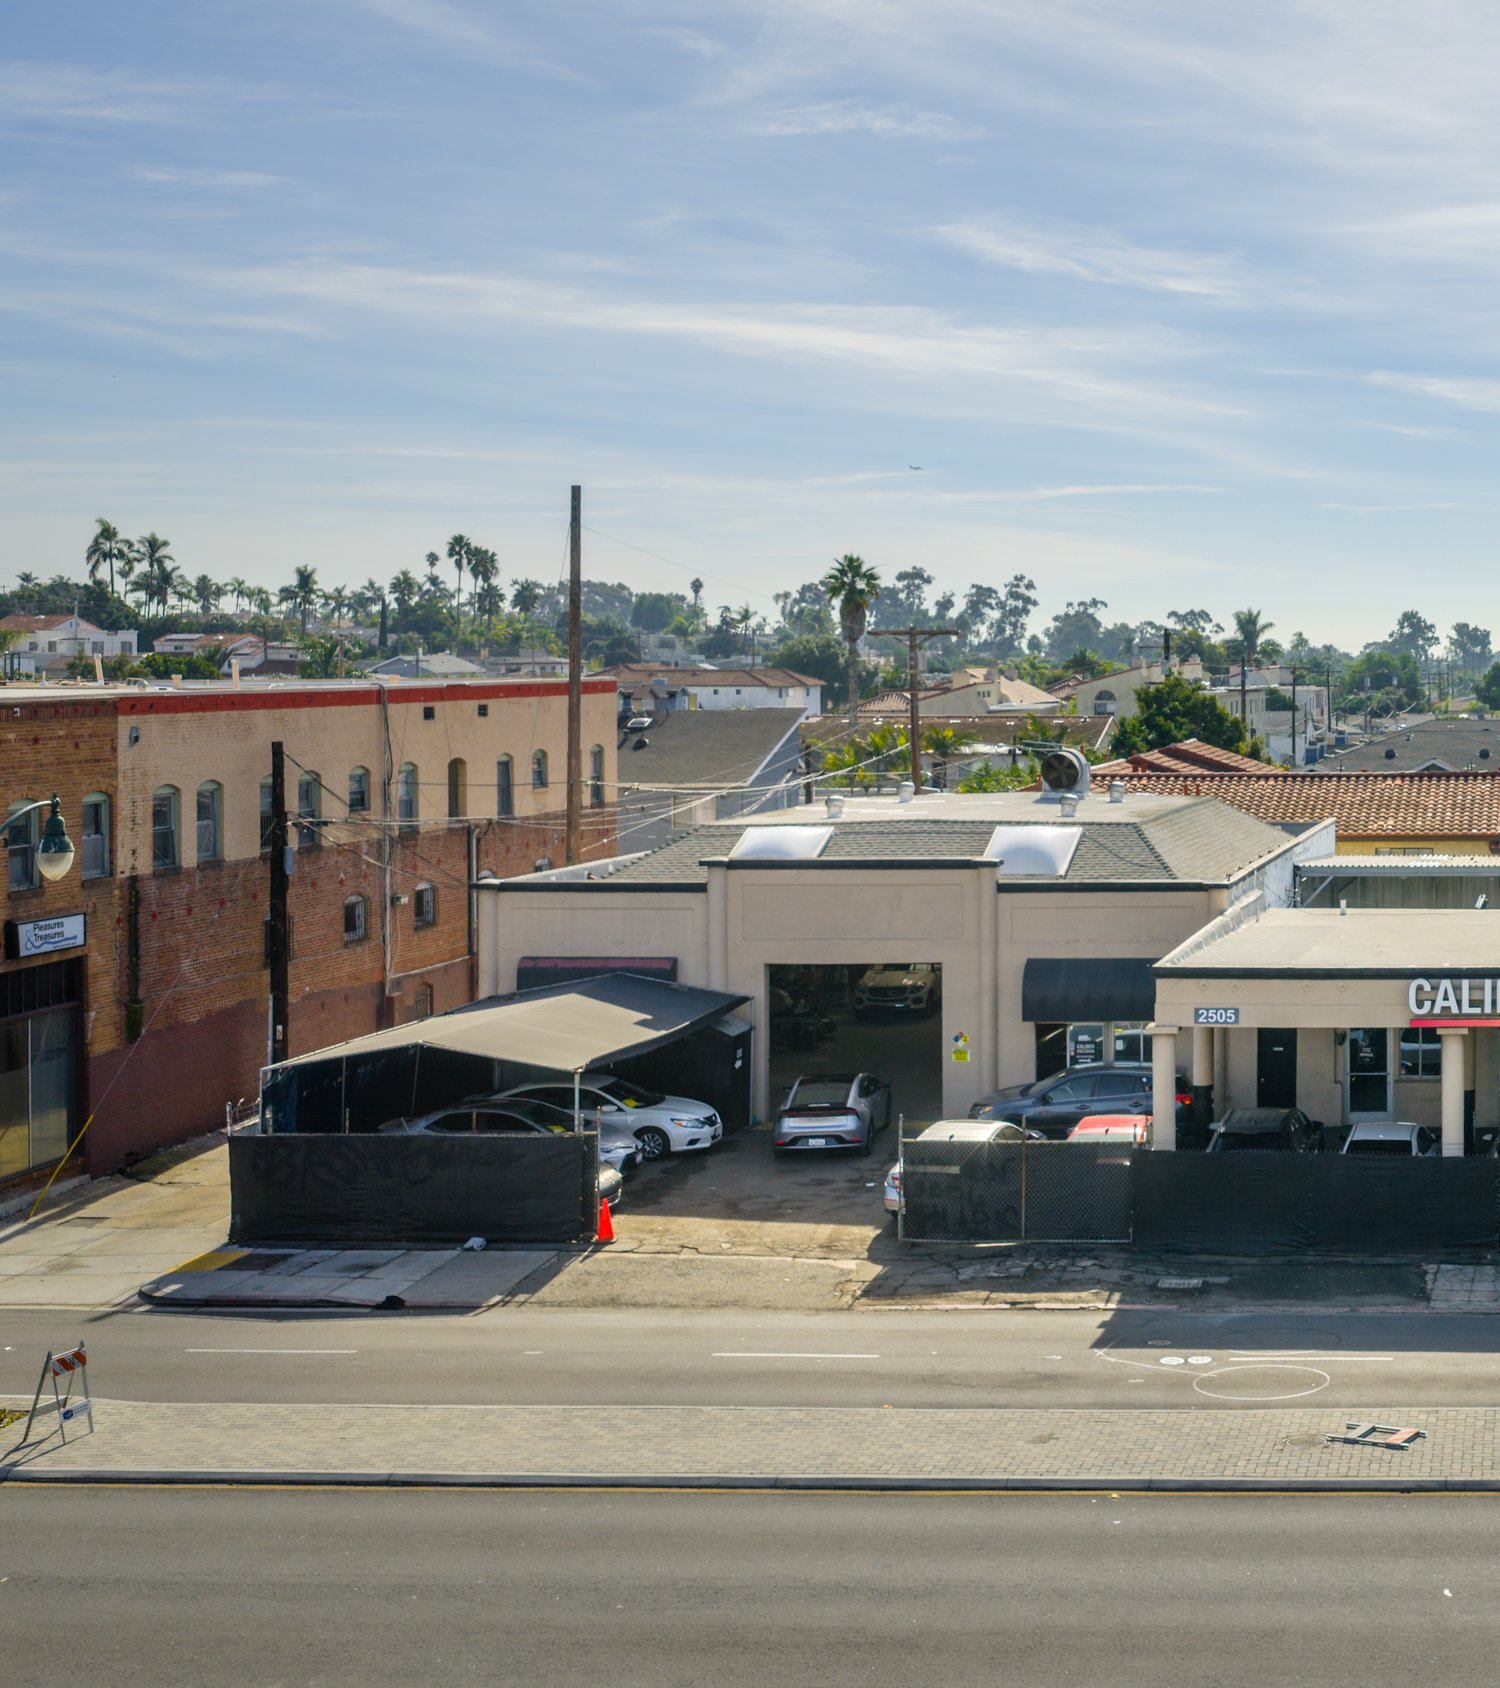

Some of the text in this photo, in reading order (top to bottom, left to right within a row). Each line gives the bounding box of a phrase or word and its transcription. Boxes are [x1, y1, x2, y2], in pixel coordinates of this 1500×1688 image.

[33, 921, 65, 933] Pleasures
[34, 930, 65, 943] Treasures
[1198, 1009, 1236, 1023] 2505
